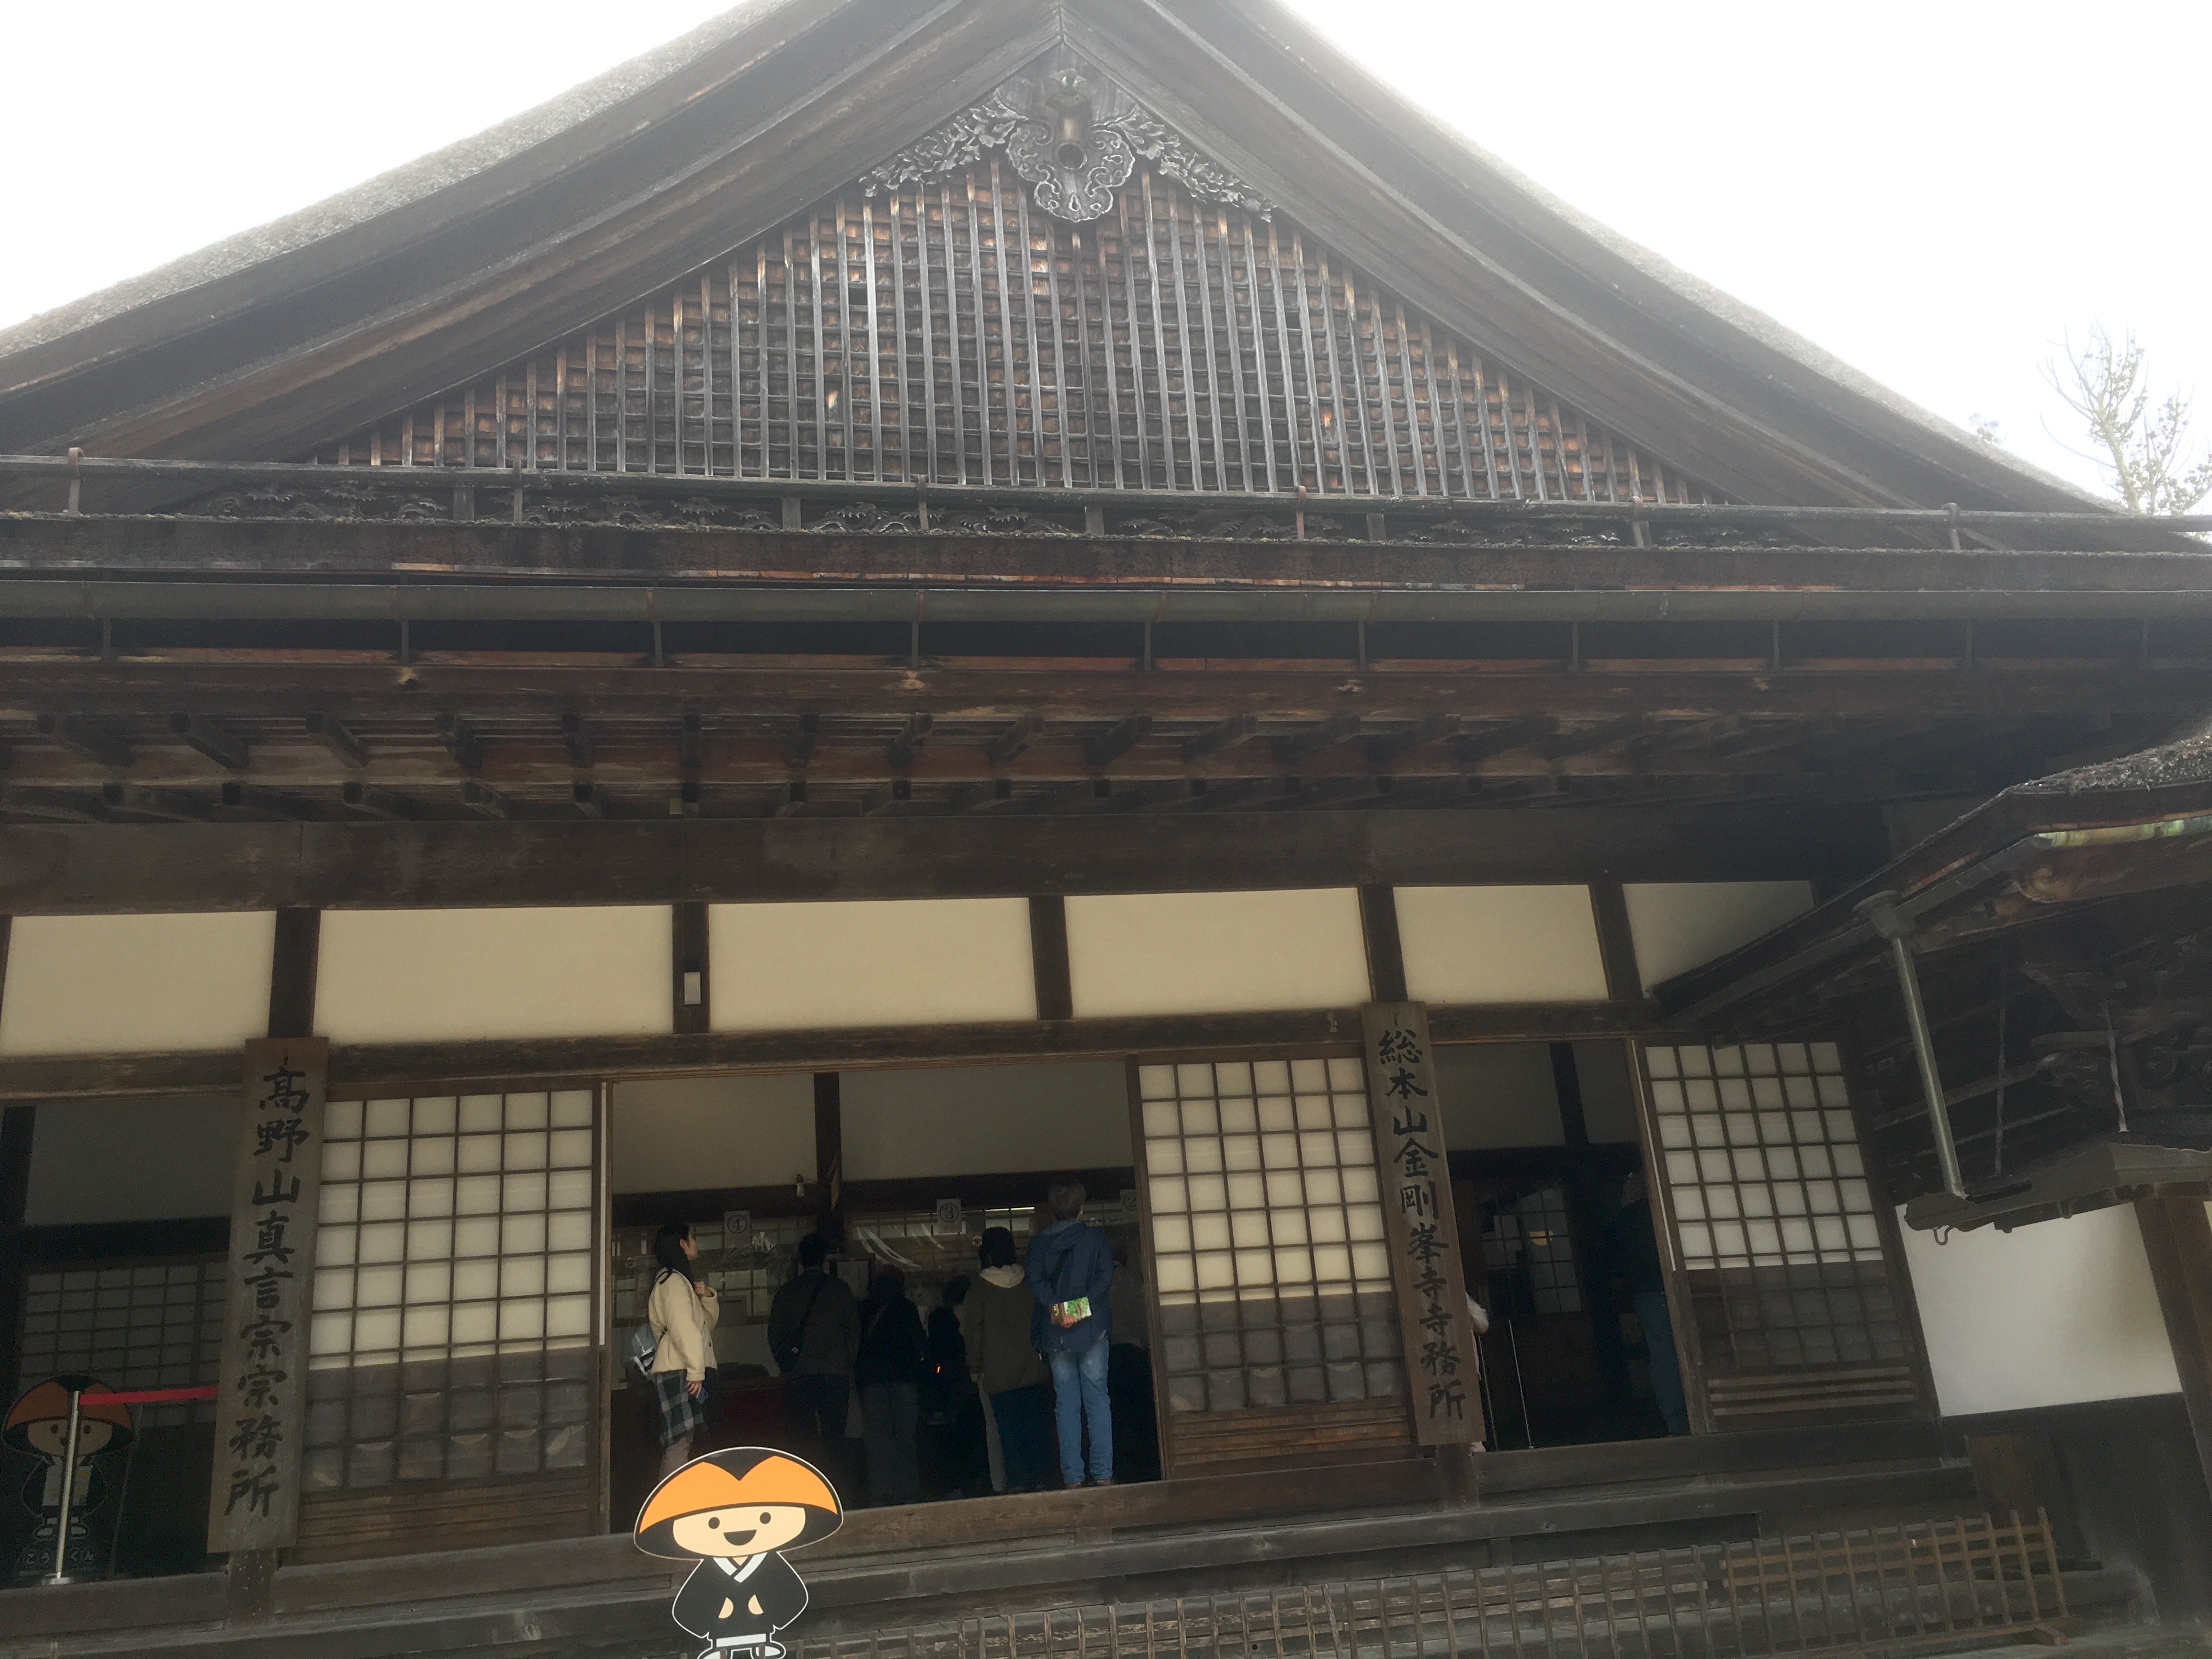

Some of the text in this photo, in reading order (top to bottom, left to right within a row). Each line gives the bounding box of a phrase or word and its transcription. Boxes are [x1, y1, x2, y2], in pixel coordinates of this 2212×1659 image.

[1378, 1029, 1466, 1420] 総本山金剛峯寺寺務所
